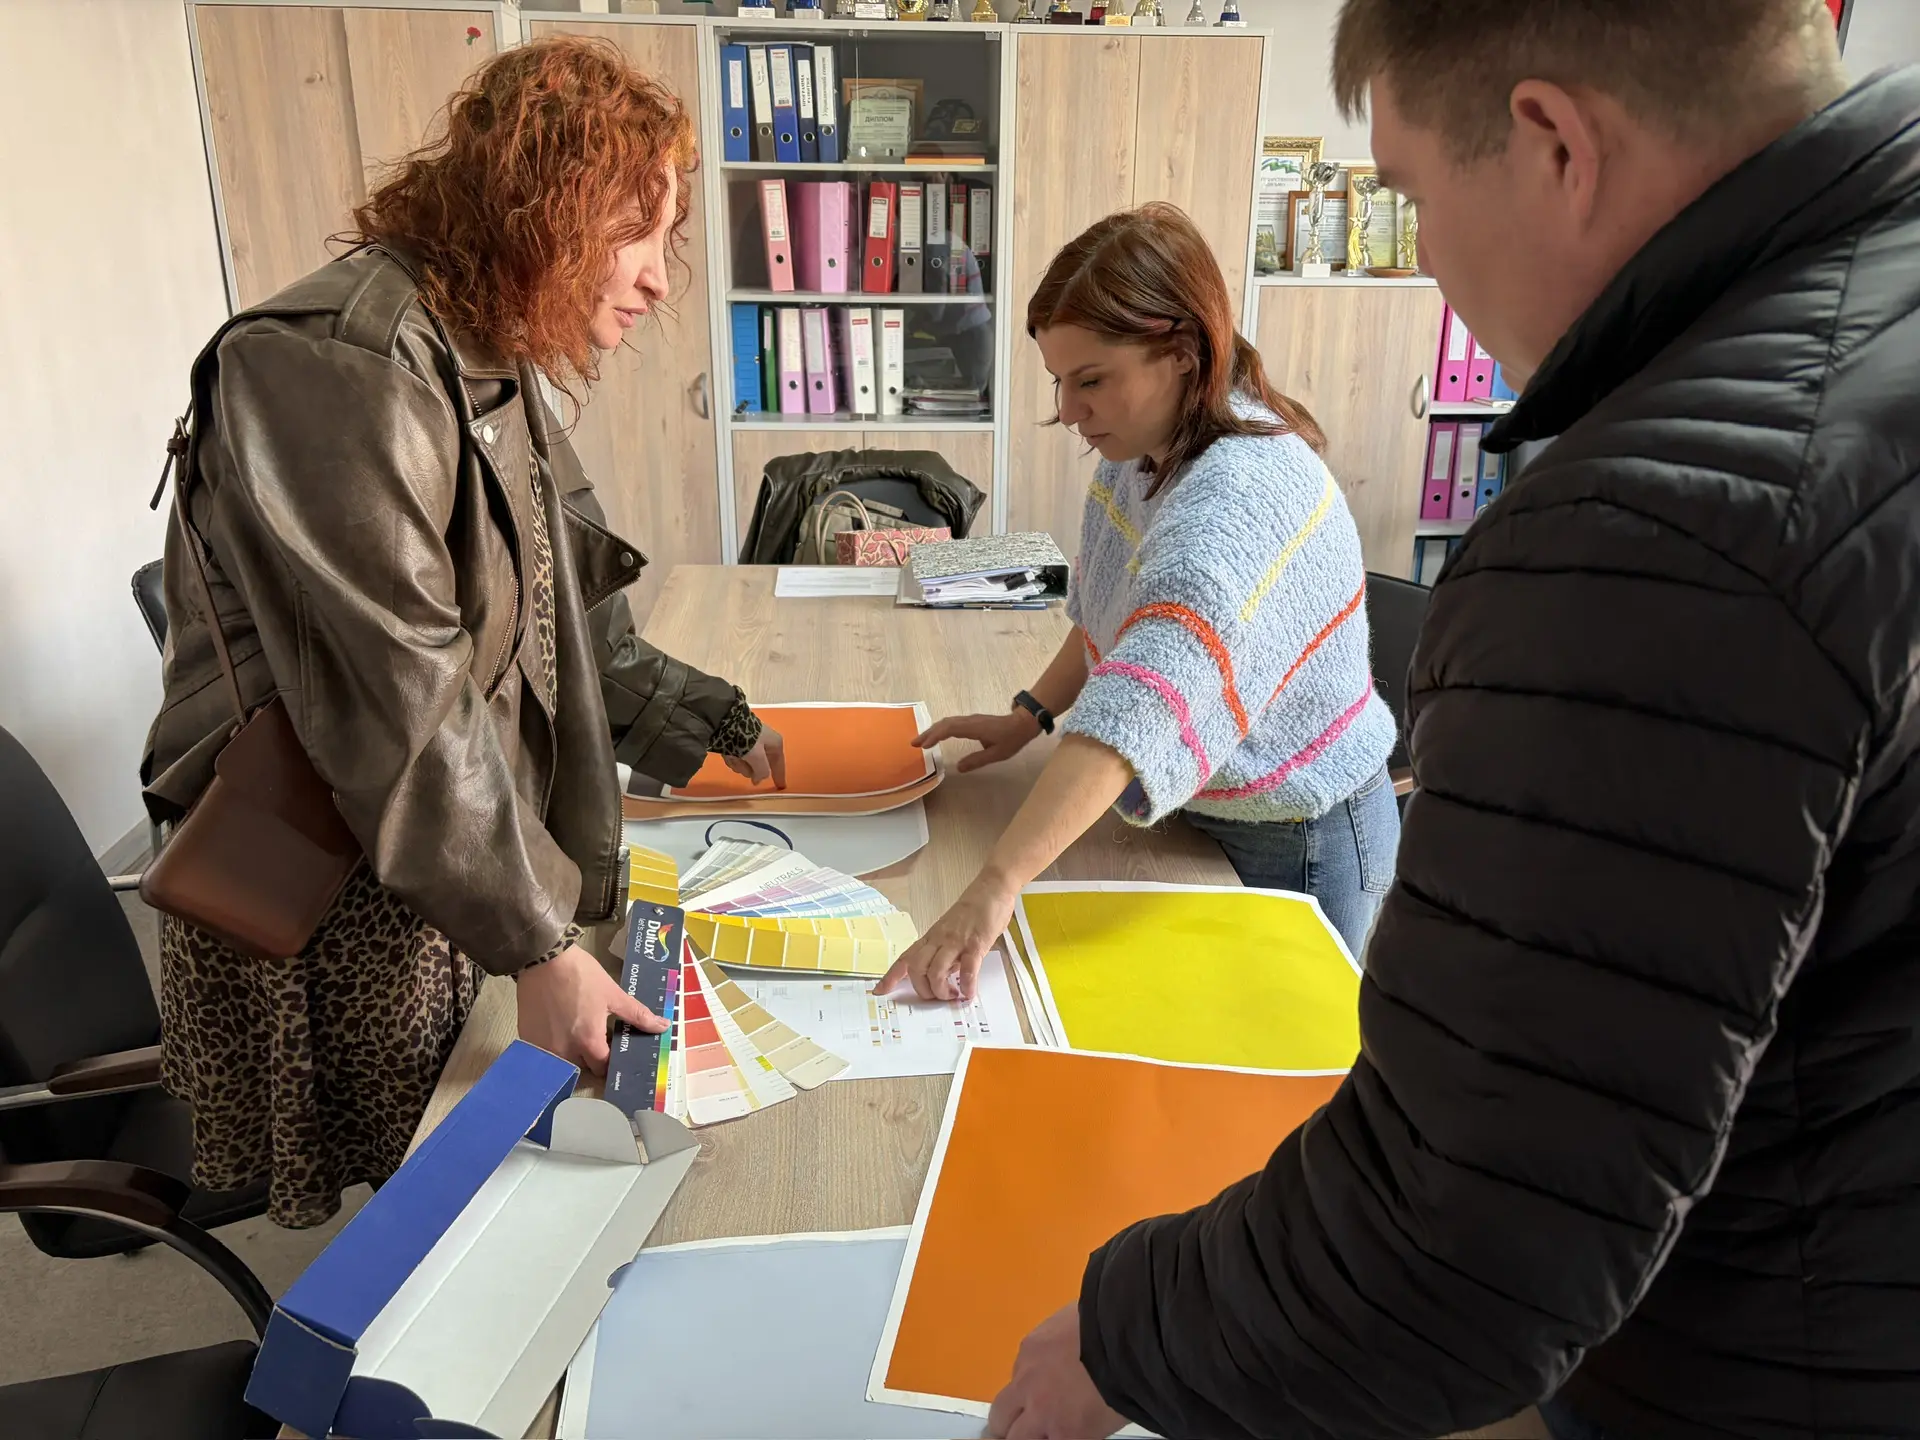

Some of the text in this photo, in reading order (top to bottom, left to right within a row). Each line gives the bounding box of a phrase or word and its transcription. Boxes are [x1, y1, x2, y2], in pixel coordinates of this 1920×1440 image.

[759, 866, 804, 891] NEUTRALS
[634, 917, 646, 954] let's colour
[643, 919, 661, 955] Dulux
[627, 963, 640, 997] КОЛЕРОВ
